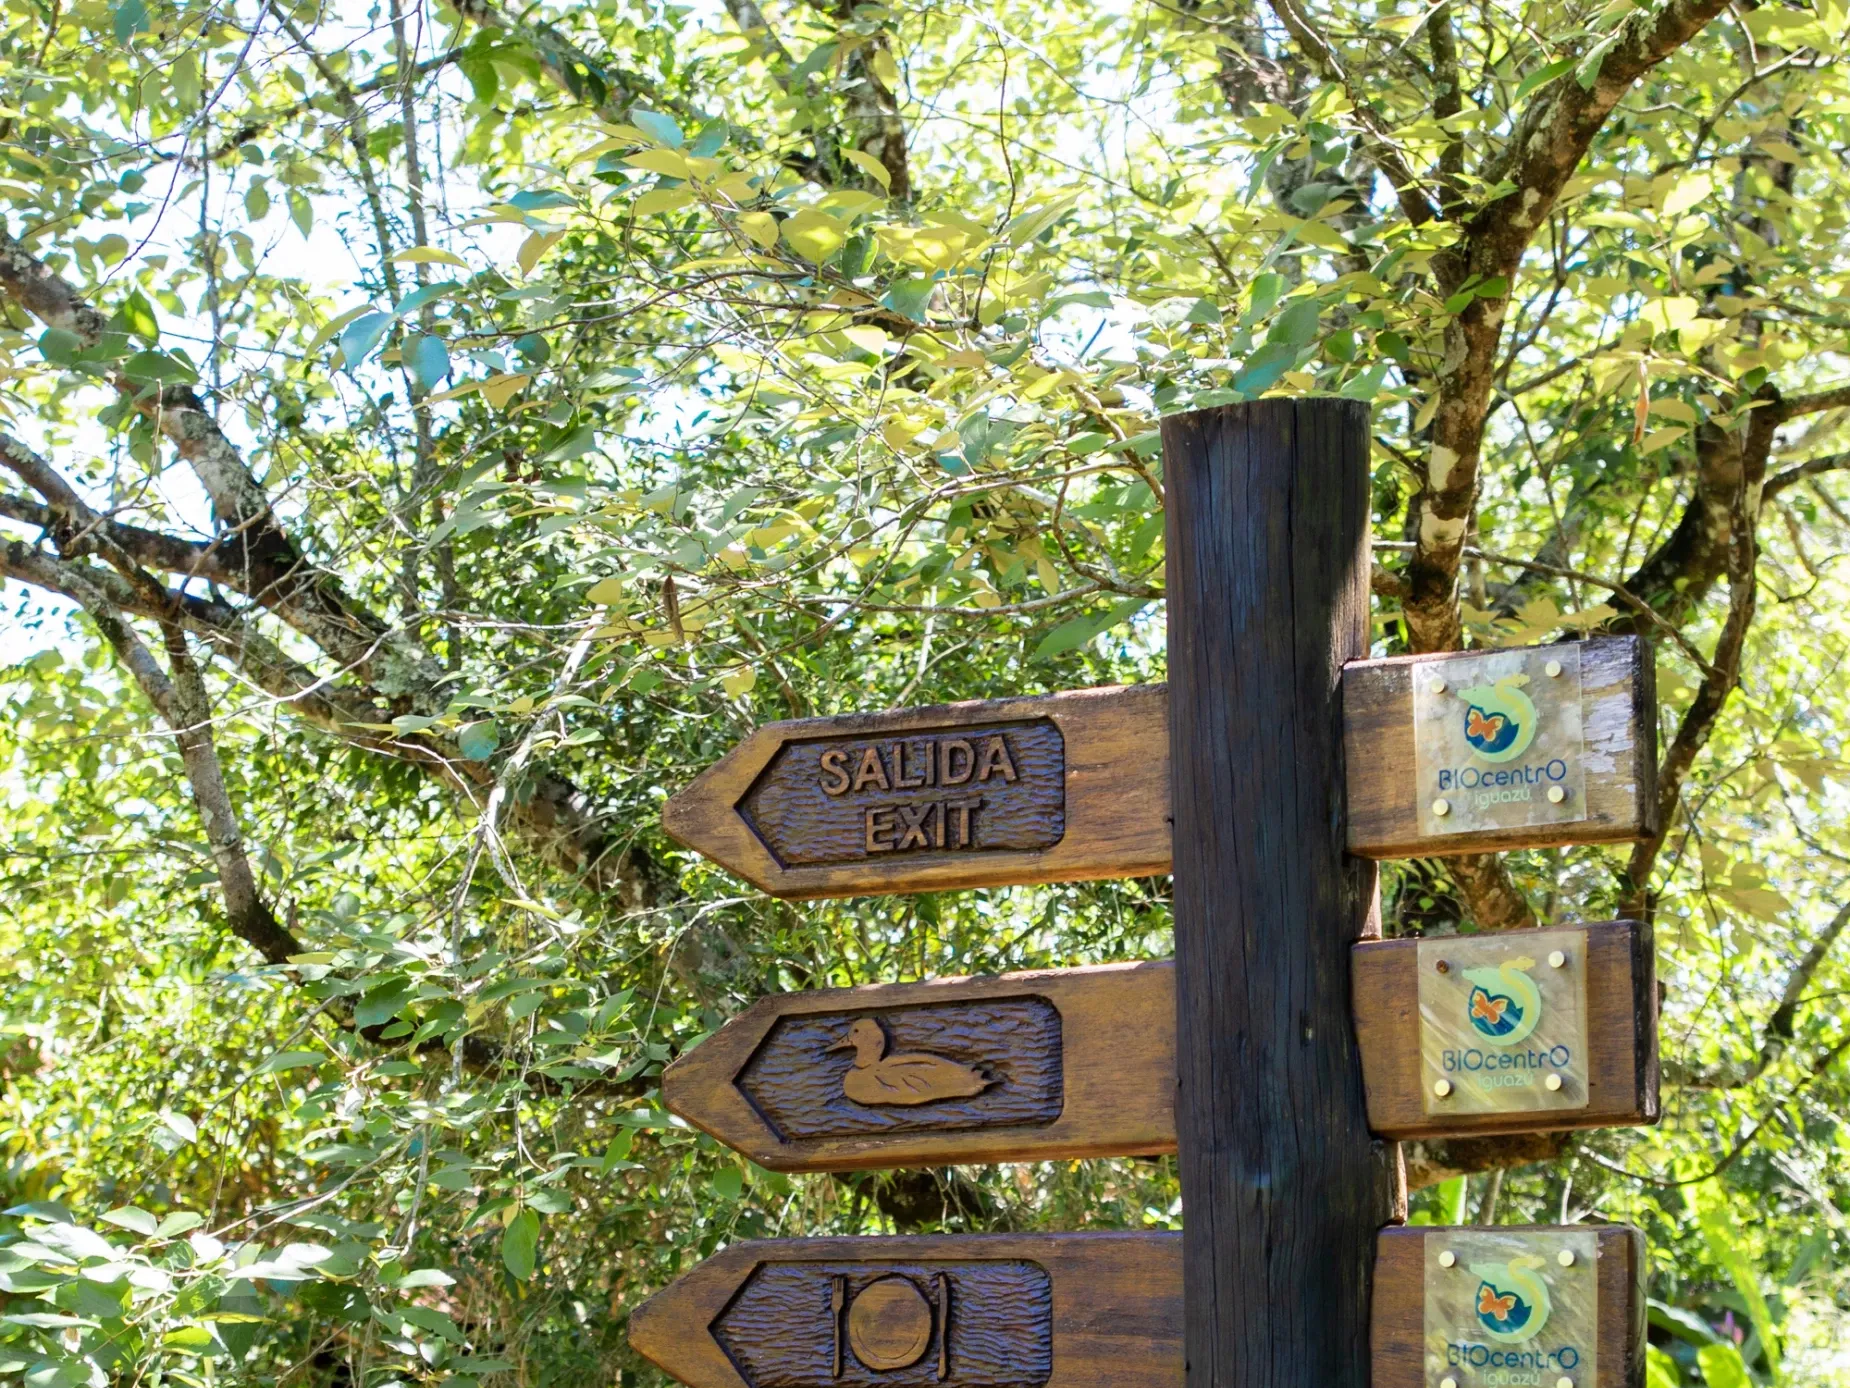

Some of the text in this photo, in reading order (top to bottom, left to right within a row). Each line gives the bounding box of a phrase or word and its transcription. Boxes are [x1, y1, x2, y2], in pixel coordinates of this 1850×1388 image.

[820, 735, 1018, 796] SALIDA
[1438, 758, 1567, 791] BIOcentrO
[1474, 784, 1531, 810] iguazú
[865, 801, 981, 852] EXIT
[1442, 1044, 1571, 1072] BIOcentrO
[1446, 1343, 1579, 1371] BIOcentrO
